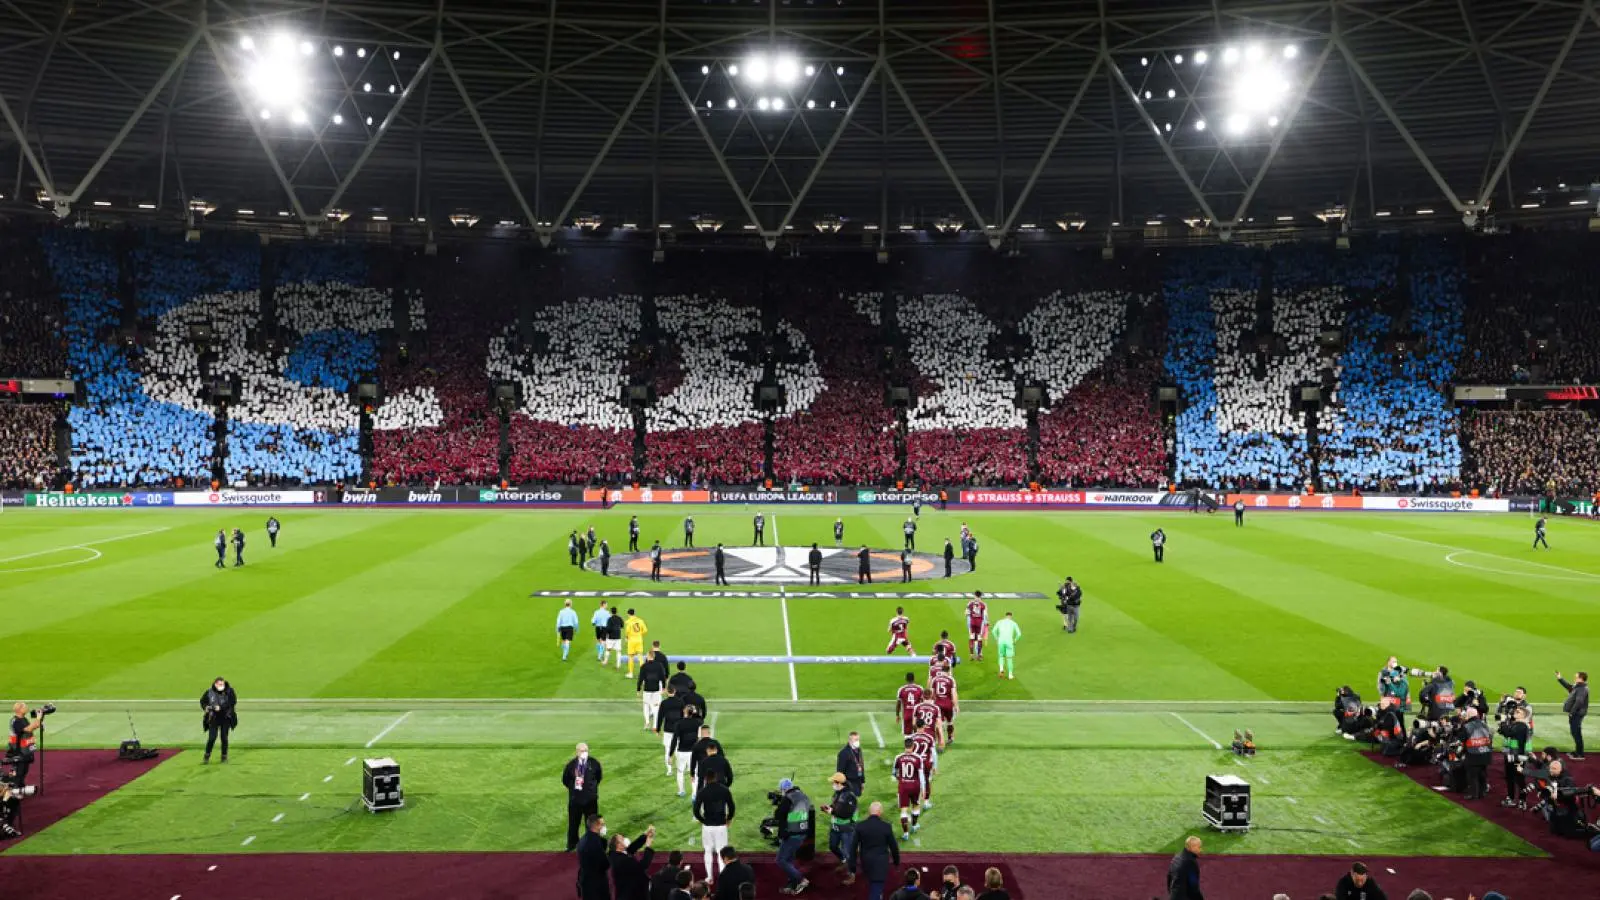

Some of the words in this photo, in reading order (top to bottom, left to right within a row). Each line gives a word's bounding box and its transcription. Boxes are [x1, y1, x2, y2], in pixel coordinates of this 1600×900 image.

[36, 493, 119, 507] Heineken
[221, 492, 282, 504] Swissquote
[342, 491, 377, 502] bwin
[408, 491, 442, 502] bwin
[483, 490, 562, 502] enterprise
[722, 493, 747, 501] UEFA
[749, 493, 787, 501] EUROPA
[788, 493, 824, 501] LEAGUE
[860, 490, 939, 502] enterprise
[977, 493, 1022, 502] STRAUSS
[1035, 493, 1080, 503] STRAUSS
[1410, 498, 1473, 511] Swissquote
[936, 682, 947, 695] 15
[907, 692, 915, 704] 4
[919, 710, 933, 725] 28
[913, 741, 928, 757] 22
[902, 761, 914, 778] 10
